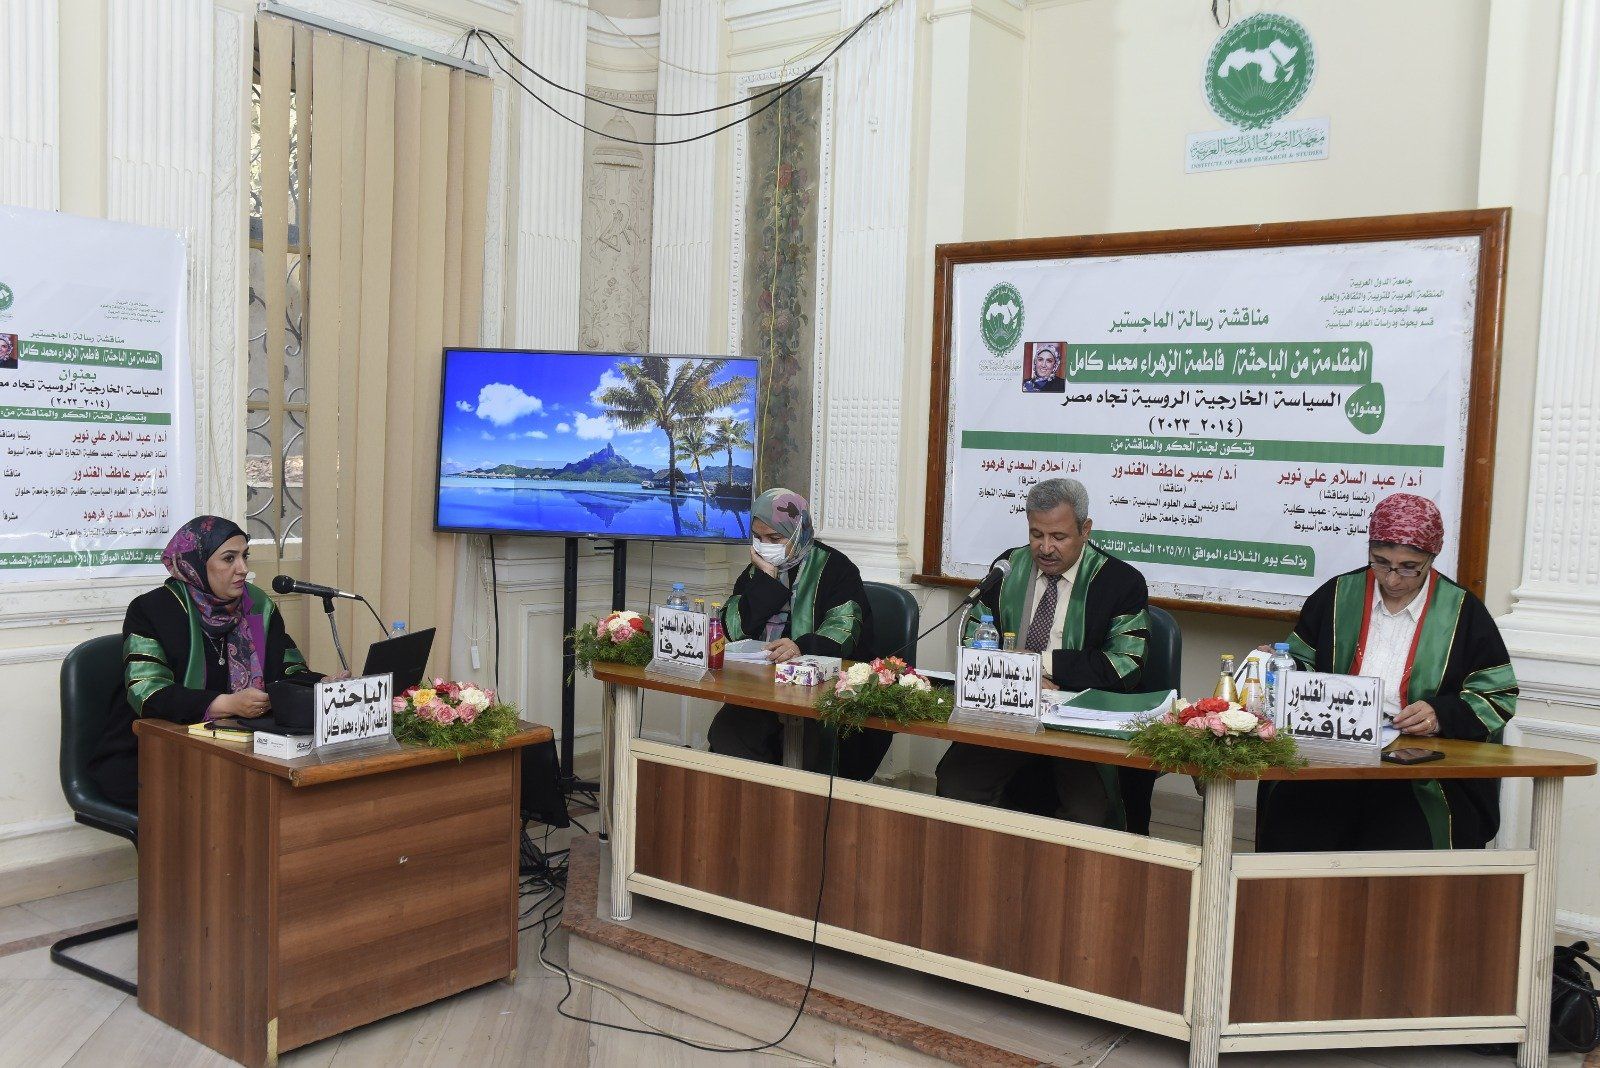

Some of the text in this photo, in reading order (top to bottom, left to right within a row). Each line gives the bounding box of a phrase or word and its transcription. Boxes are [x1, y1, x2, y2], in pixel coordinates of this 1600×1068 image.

[1254, 154, 1287, 162] RESEARCH
[1351, 278, 1412, 288] جامعة الدول العربية
[1320, 290, 1444, 302] المنظمة العربية للتربية والثقافة والعلوم
[1334, 306, 1355, 315] العربية
[1388, 305, 1410, 314] البحوث
[1107, 307, 1269, 333] مناقشة رسالة الماجستير
[1326, 320, 1353, 328] السياسية
[1355, 320, 1373, 329] العلوم
[1400, 319, 1417, 328] بحوث
[1420, 318, 1434, 327] قسم
[29, 330, 125, 344] مناقشة رسالة الماجستير
[19, 343, 38, 357] كامل
[41, 348, 57, 356] محمد
[58, 348, 78, 362] الزهراء
[80, 348, 99, 361] فاطمة
[128, 352, 136, 365] من
[137, 352, 160, 365] المقدمة
[1070, 349, 1103, 376] كامل
[1107, 353, 1138, 372] محمد
[1140, 349, 1182, 378] الزهراء
[1185, 348, 1225, 375] فاطمة
[1291, 350, 1309, 378] من
[1312, 348, 1368, 375] المقدمة
[59, 369, 97, 382] بعنوان
[13, 379, 163, 398] السياسة الخارجية الروسية تجاه
[1061, 388, 1341, 412] السياسة الخارجية الروسية تجاه مصر
[18, 409, 58, 419] والمناقشة
[93, 412, 113, 421] لجنة
[1347, 401, 1382, 419] بعنوان
[115, 413, 147, 422] وتتكون
[72, 430, 89, 443] نوير
[92, 431, 106, 445] علي
[109, 431, 132, 443] السلام
[136, 433, 150, 445] عبد
[1125, 439, 1163, 452] والمناقشة
[1165, 441, 1195, 452] الحكم
[1197, 441, 1218, 454] لجنة
[1220, 441, 1255, 457] وتتكون
[981, 458, 1005, 472] فرهود
[1007, 459, 1036, 473] السعدي
[1040, 458, 1063, 472] أحلام
[1112, 462, 1148, 478] الغندور
[1152, 463, 1185, 478] عاطف
[72, 466, 102, 481] الغندور
[106, 466, 130, 478] عاطف
[133, 469, 151, 482] عبير
[1187, 470, 1213, 483] عبير
[1277, 468, 1302, 486] نوير
[1304, 468, 1327, 488] علي
[1328, 469, 1366, 487] السلام
[1372, 473, 1396, 490] عبد
[978, 488, 997, 499] التجارة
[999, 489, 1016, 499] كلية
[1010, 504, 1026, 514] حلوان
[1133, 497, 1238, 513] أستاذ ورئيس قسم العلوم السياسية
[1283, 504, 1305, 514] كلية
[84, 508, 105, 522] فرهود
[1140, 513, 1202, 526] التجارة جامعة حلوان
[1332, 508, 1366, 519] السياسية
[1294, 522, 1317, 531] أسيوط
[1318, 524, 1341, 535] جامعة
[1100, 540, 1126, 552] الثالثة
[1128, 543, 1155, 554] الساعة
[1192, 548, 1222, 561] الموافق
[1223, 551, 1261, 564] الثلاثاء
[1262, 555, 1278, 567] يوم
[1280, 554, 1308, 570] وذلك
[965, 656, 980, 682] نوير
[324, 679, 387, 715] الباحثة
[1288, 679, 1326, 707] الغندور
[1327, 690, 1354, 712] عبير
